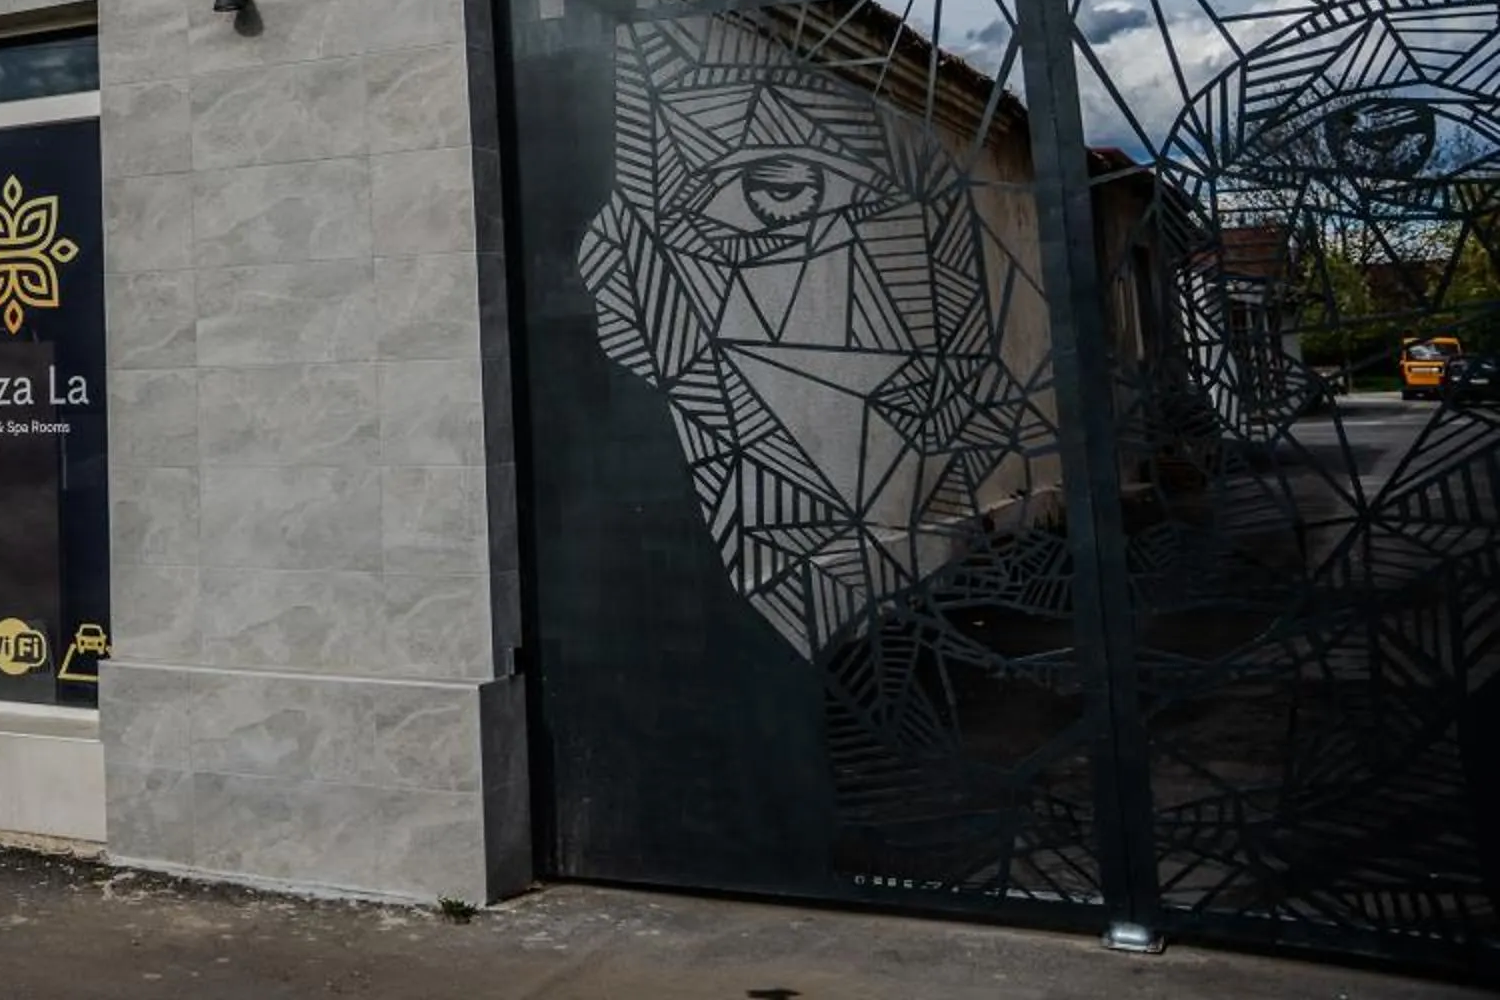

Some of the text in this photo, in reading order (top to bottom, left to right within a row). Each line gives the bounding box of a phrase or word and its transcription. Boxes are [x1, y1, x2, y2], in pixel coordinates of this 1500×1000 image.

[49, 364, 90, 406] La
[7, 421, 29, 436] Spa
[31, 420, 71, 434] Rooms
